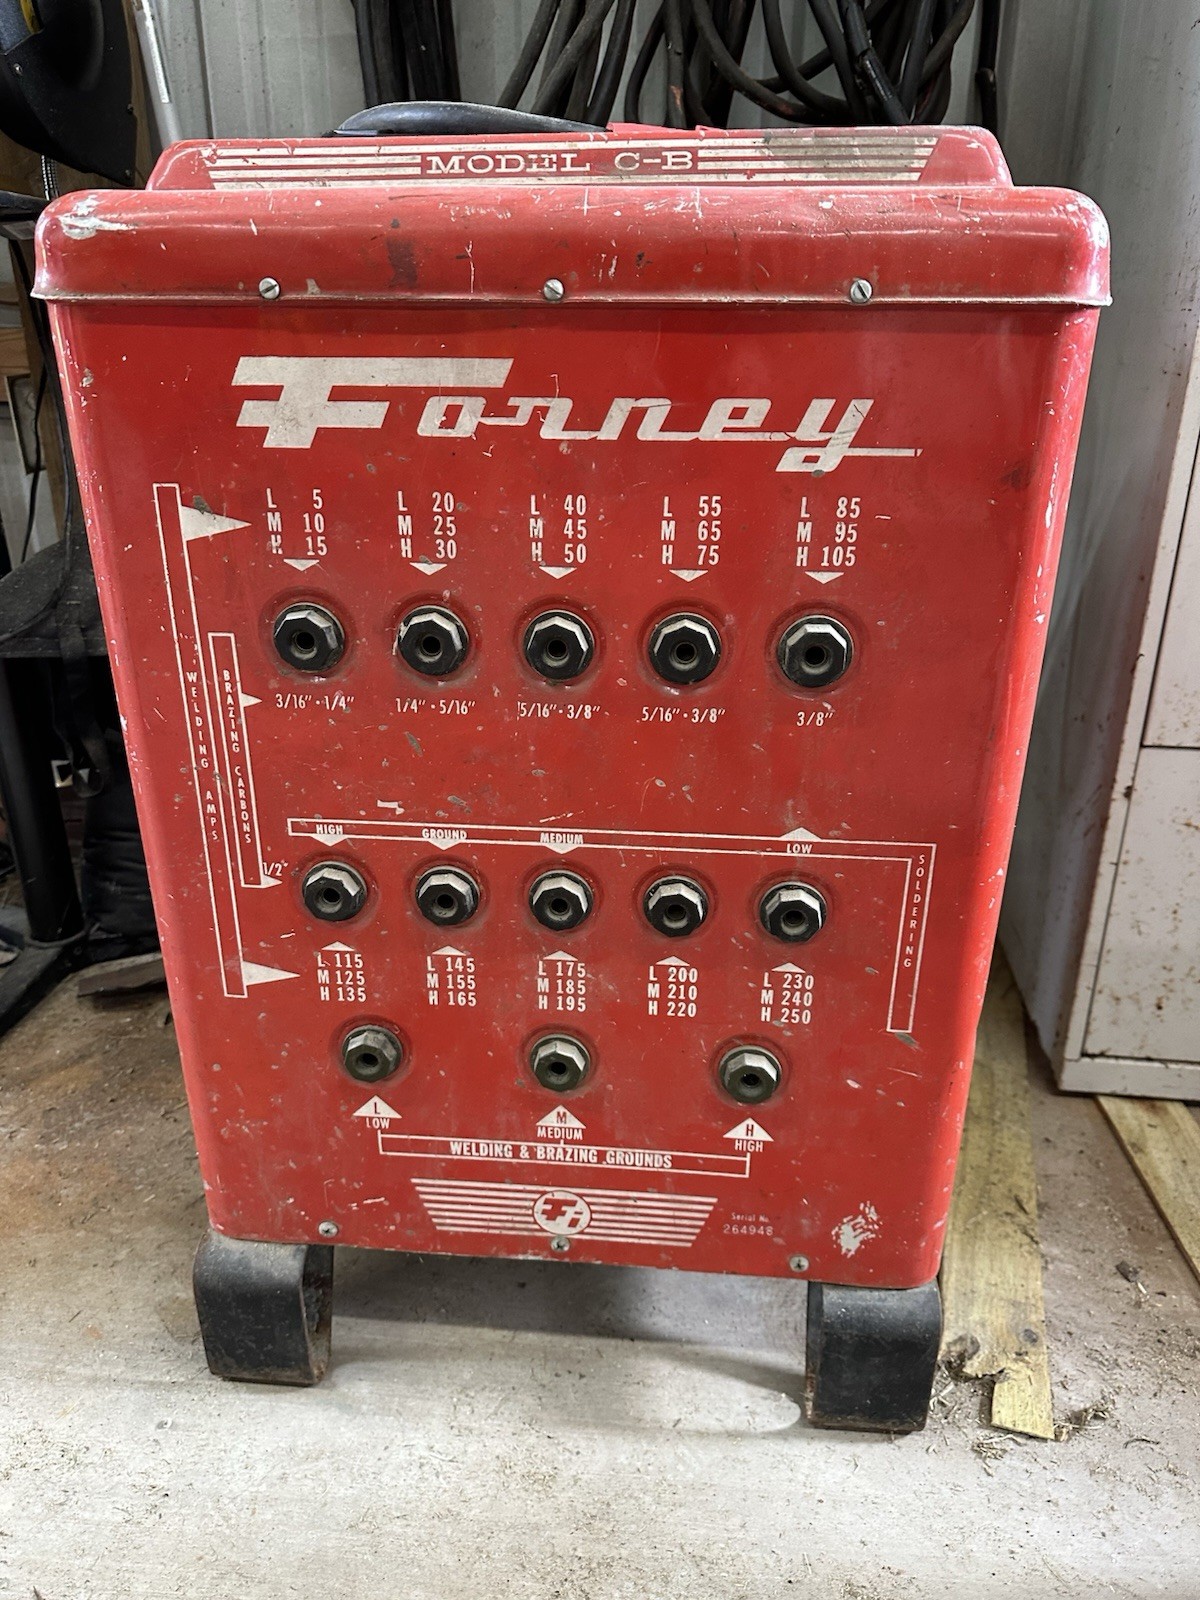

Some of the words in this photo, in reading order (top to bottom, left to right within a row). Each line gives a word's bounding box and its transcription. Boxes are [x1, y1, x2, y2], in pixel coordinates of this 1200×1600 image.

[426, 151, 590, 176] MODEL
[613, 150, 694, 172] C-B
[231, 356, 922, 472] Forney
[266, 488, 277, 508] L
[313, 489, 323, 509] 5
[397, 491, 408, 511] L
[432, 492, 455, 513] 20
[531, 495, 539, 515] L
[564, 495, 587, 516] 40
[664, 496, 672, 517] L
[699, 496, 722, 518] 55
[801, 496, 810, 518] L
[836, 497, 861, 519] 85
[267, 512, 282, 532] M
[303, 513, 325, 533] 10
[397, 515, 413, 536] M
[433, 516, 457, 537] 25
[529, 518, 543, 539] M
[564, 519, 587, 540] 45
[661, 520, 675, 541] M
[697, 521, 721, 541] 65
[797, 522, 812, 543] M
[835, 522, 858, 543] 95
[271, 534, 283, 554] H
[306, 536, 328, 556] 15
[400, 538, 413, 558] H
[436, 539, 457, 560] 30
[531, 542, 542, 562] H
[564, 543, 587, 564] 50
[662, 545, 673, 565] H
[697, 545, 720, 566] 75
[796, 546, 808, 566] H
[821, 546, 856, 567] 105
[797, 711, 834, 727] 3/8"
[186, 672, 209, 768] WELDING
[206, 790, 219, 841] AMPS
[223, 670, 240, 753] BRAZING
[234, 766, 251, 843] CARBONS
[316, 824, 343, 836] HIGH
[422, 828, 468, 840] GROUND
[540, 832, 584, 845] MEDIUM
[787, 843, 812, 854] LOW
[903, 854, 925, 968] SOLDERING
[317, 955, 326, 968] L
[335, 954, 363, 969] 115
[427, 956, 435, 971] L
[446, 957, 475, 973] 145
[539, 961, 547, 976] L
[556, 962, 586, 978] 175
[318, 970, 330, 984] M
[336, 970, 365, 986] 125
[427, 973, 439, 988] M
[447, 974, 476, 989] 155
[649, 966, 658, 981] L
[668, 967, 698, 983] 200
[764, 972, 772, 987] L
[783, 974, 815, 990] 230
[320, 987, 330, 1001] H
[337, 988, 366, 1002] 135
[537, 978, 550, 993] M
[556, 979, 586, 995] 185
[648, 983, 660, 998] M
[667, 985, 697, 1000] 210
[429, 991, 439, 1006] H
[448, 992, 477, 1007] 165
[539, 996, 548, 1010] H
[556, 996, 586, 1012] 195
[761, 990, 773, 1005] M
[781, 990, 812, 1007] 240
[649, 1001, 658, 1016] H
[667, 1002, 697, 1018] 220
[761, 1007, 771, 1022] H
[781, 1008, 811, 1024] 250
[374, 1101, 380, 1114] L
[366, 1117, 390, 1129] LOW
[556, 1111, 567, 1124] M
[537, 1126, 583, 1141] MEDIUM
[746, 1124, 754, 1137] H
[450, 1141, 513, 1158] WELDING
[519, 1145, 530, 1159] &
[536, 1146, 598, 1163] BRAZING
[605, 1151, 672, 1168] GROUNDS
[734, 1139, 764, 1153] HIGH
[731, 1211, 756, 1222] Serial
